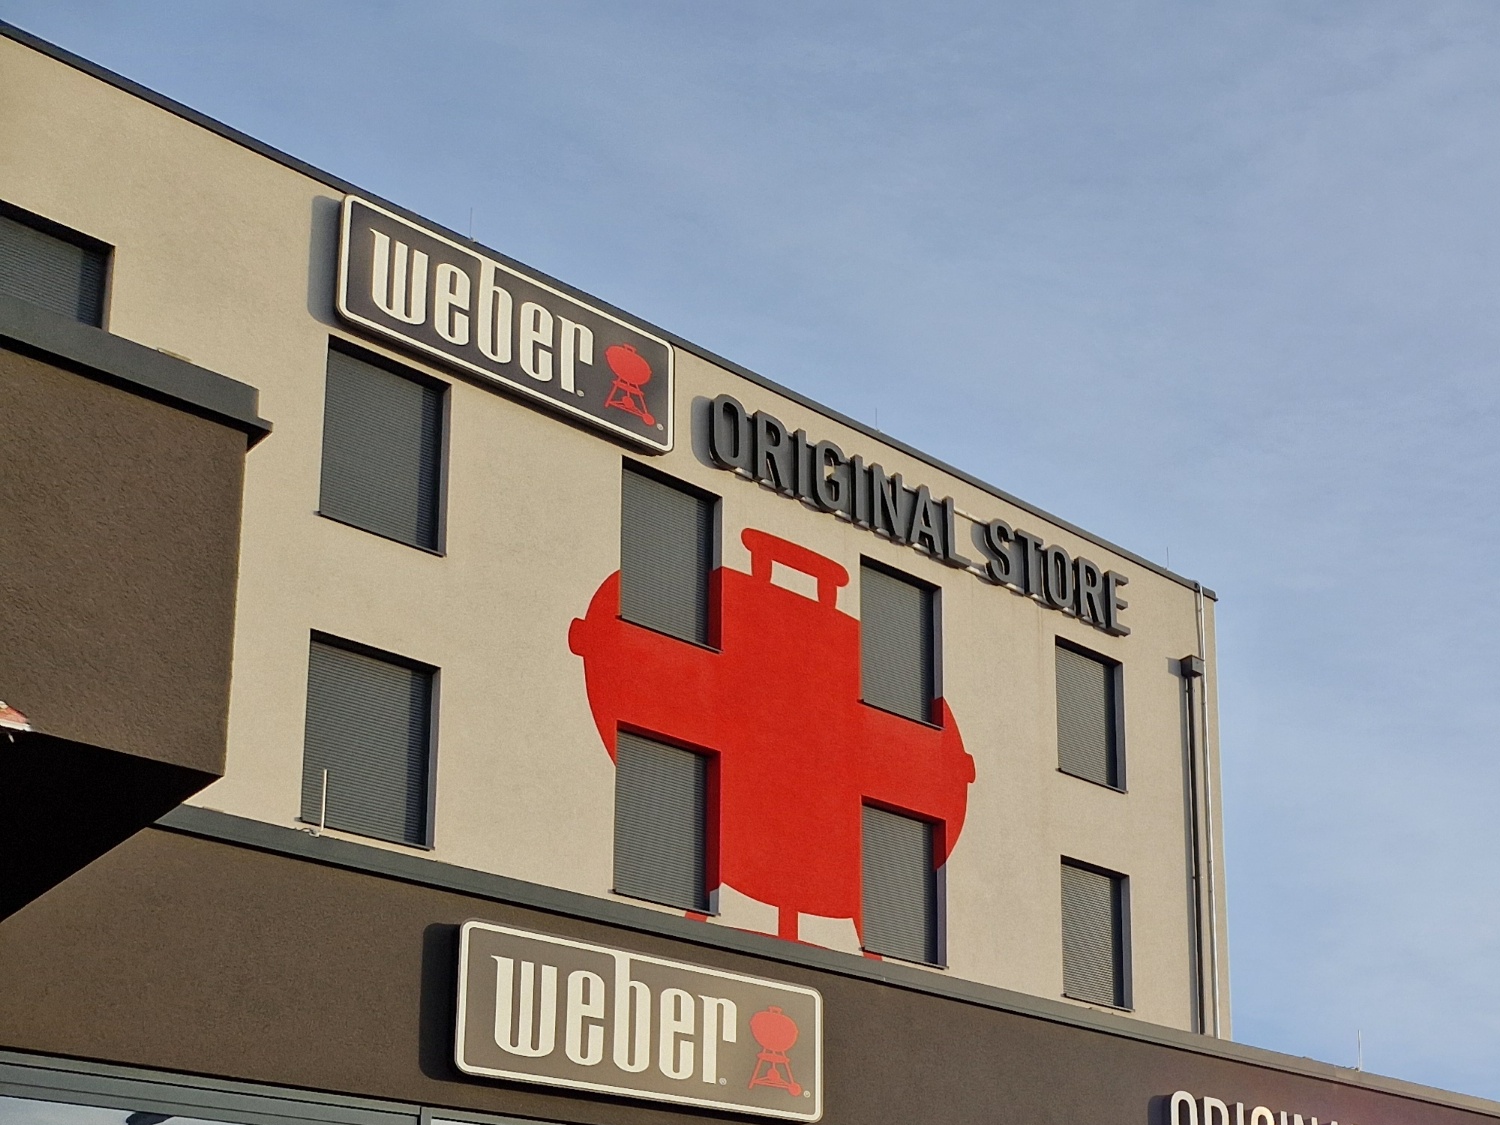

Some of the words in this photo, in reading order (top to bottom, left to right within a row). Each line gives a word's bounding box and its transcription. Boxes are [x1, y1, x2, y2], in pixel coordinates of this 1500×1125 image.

[369, 228, 594, 394] weber
[709, 394, 971, 569] ORIGINAL
[985, 518, 1131, 637] STORE
[491, 952, 738, 1085] weber
